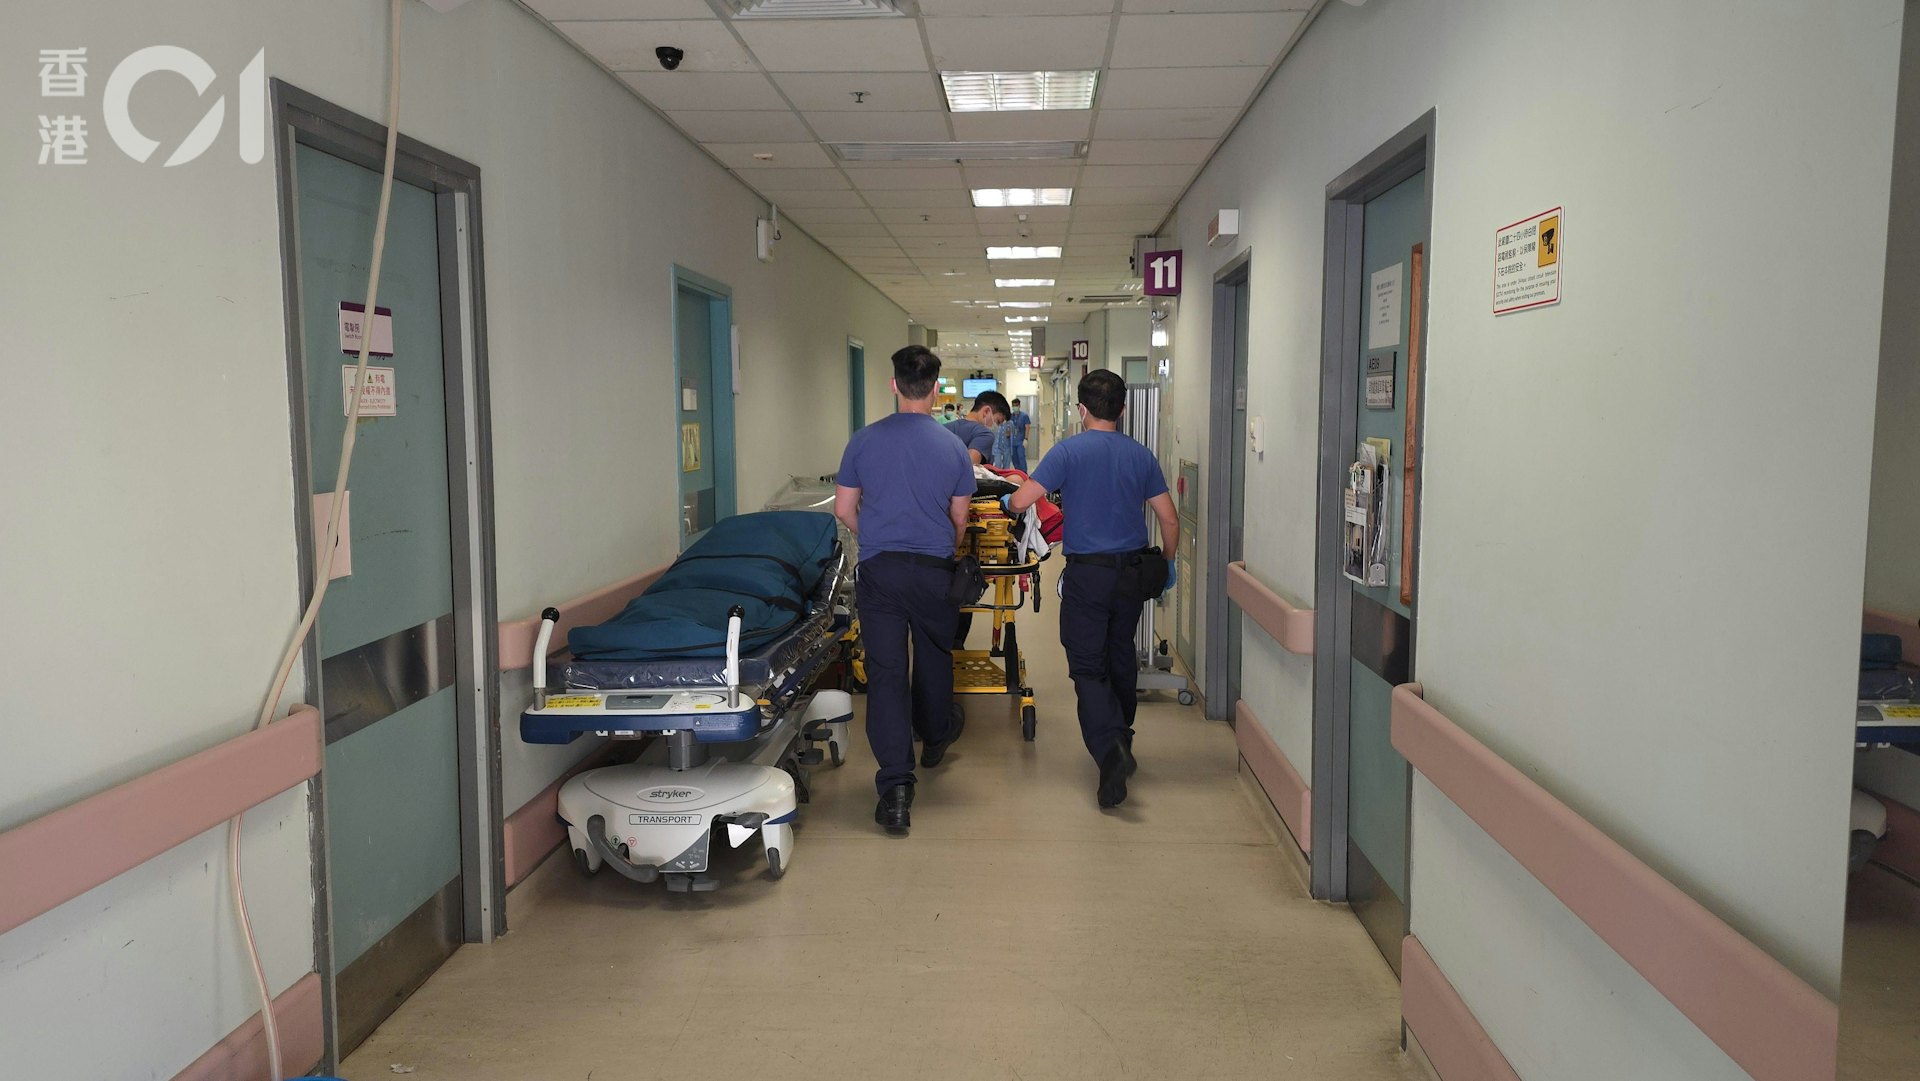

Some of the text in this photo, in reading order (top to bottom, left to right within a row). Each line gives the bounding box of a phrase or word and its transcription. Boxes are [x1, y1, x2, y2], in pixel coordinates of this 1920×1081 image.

[1150, 256, 1176, 289] 11
[1073, 342, 1087, 358] 10
[1032, 356, 1039, 368] 5
[649, 789, 692, 799] stryker
